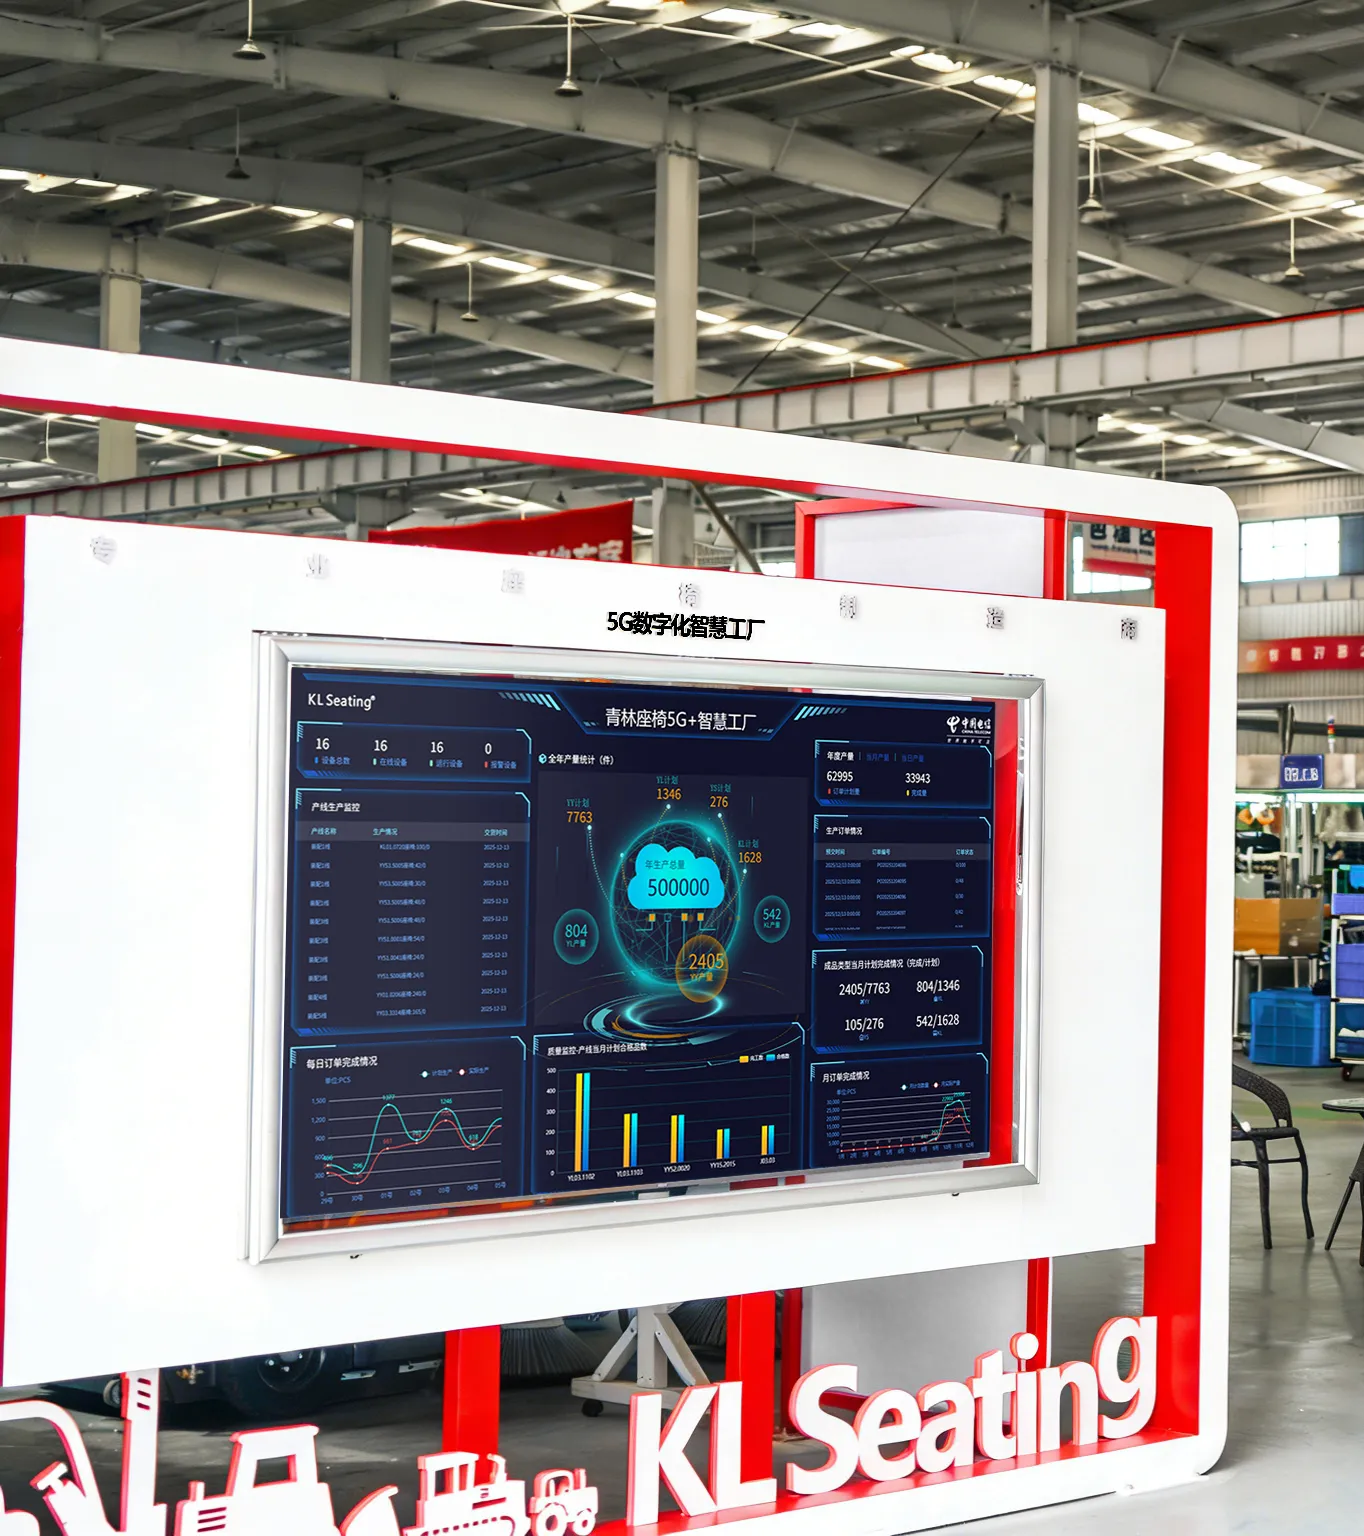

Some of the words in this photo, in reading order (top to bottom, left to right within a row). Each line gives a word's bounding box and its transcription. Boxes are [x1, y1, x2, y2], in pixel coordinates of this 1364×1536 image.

[607, 611, 765, 640] 5G数字化智慧工厂
[308, 694, 323, 706] KL
[605, 708, 756, 732] 青林座椅5G+智慧工厂
[316, 738, 329, 750] 16
[374, 740, 387, 751] 16
[431, 742, 444, 753] 16
[485, 743, 492, 754] 0
[827, 751, 854, 761] 年度产量
[827, 771, 853, 782] 62995
[905, 773, 930, 784] 33943
[657, 788, 681, 800] 1346
[311, 803, 360, 812] 产线生产监控
[710, 796, 728, 808] 276
[567, 811, 593, 823] 7763
[826, 827, 863, 835] 生产订单情况
[738, 852, 762, 863] 1628
[645, 860, 685, 869] 年生产总量
[648, 878, 709, 897] 500000
[763, 908, 781, 920] 542
[565, 924, 588, 938] 804
[689, 953, 724, 969] 2405
[839, 982, 890, 996] 2405/7763
[917, 979, 960, 994] 804/1346
[845, 1018, 884, 1032] 105/276
[916, 1014, 959, 1028] 542/1628
[306, 1056, 377, 1069] 每日订单完成情况
[822, 1071, 870, 1083] 月订单完成情况
[627, 1381, 777, 1527] KL
[786, 1315, 1157, 1495] Seating
